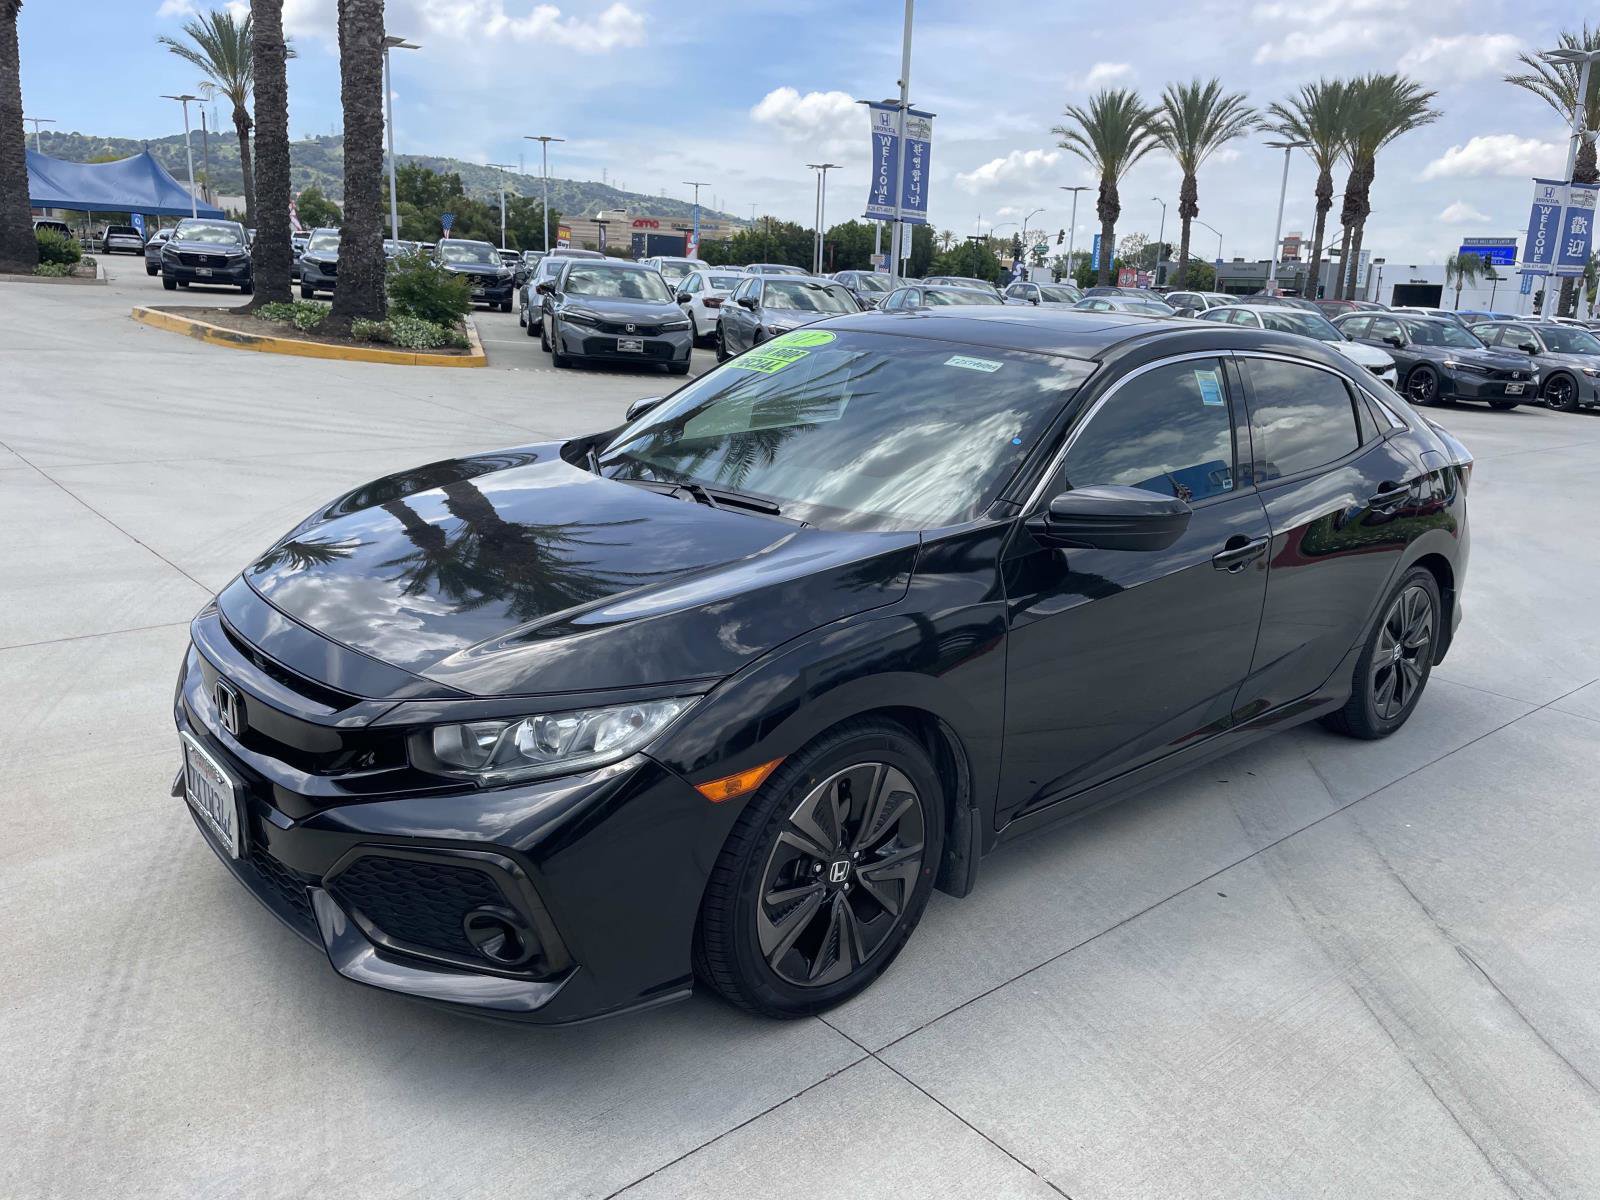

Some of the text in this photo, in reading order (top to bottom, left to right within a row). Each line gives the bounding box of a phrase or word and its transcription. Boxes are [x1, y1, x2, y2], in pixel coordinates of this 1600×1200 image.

[877, 134, 892, 204] WELCOME
[1536, 197, 1560, 205] HONDA
[1533, 205, 1553, 262] WELCOME
[1566, 215, 1588, 257] 歡迎
